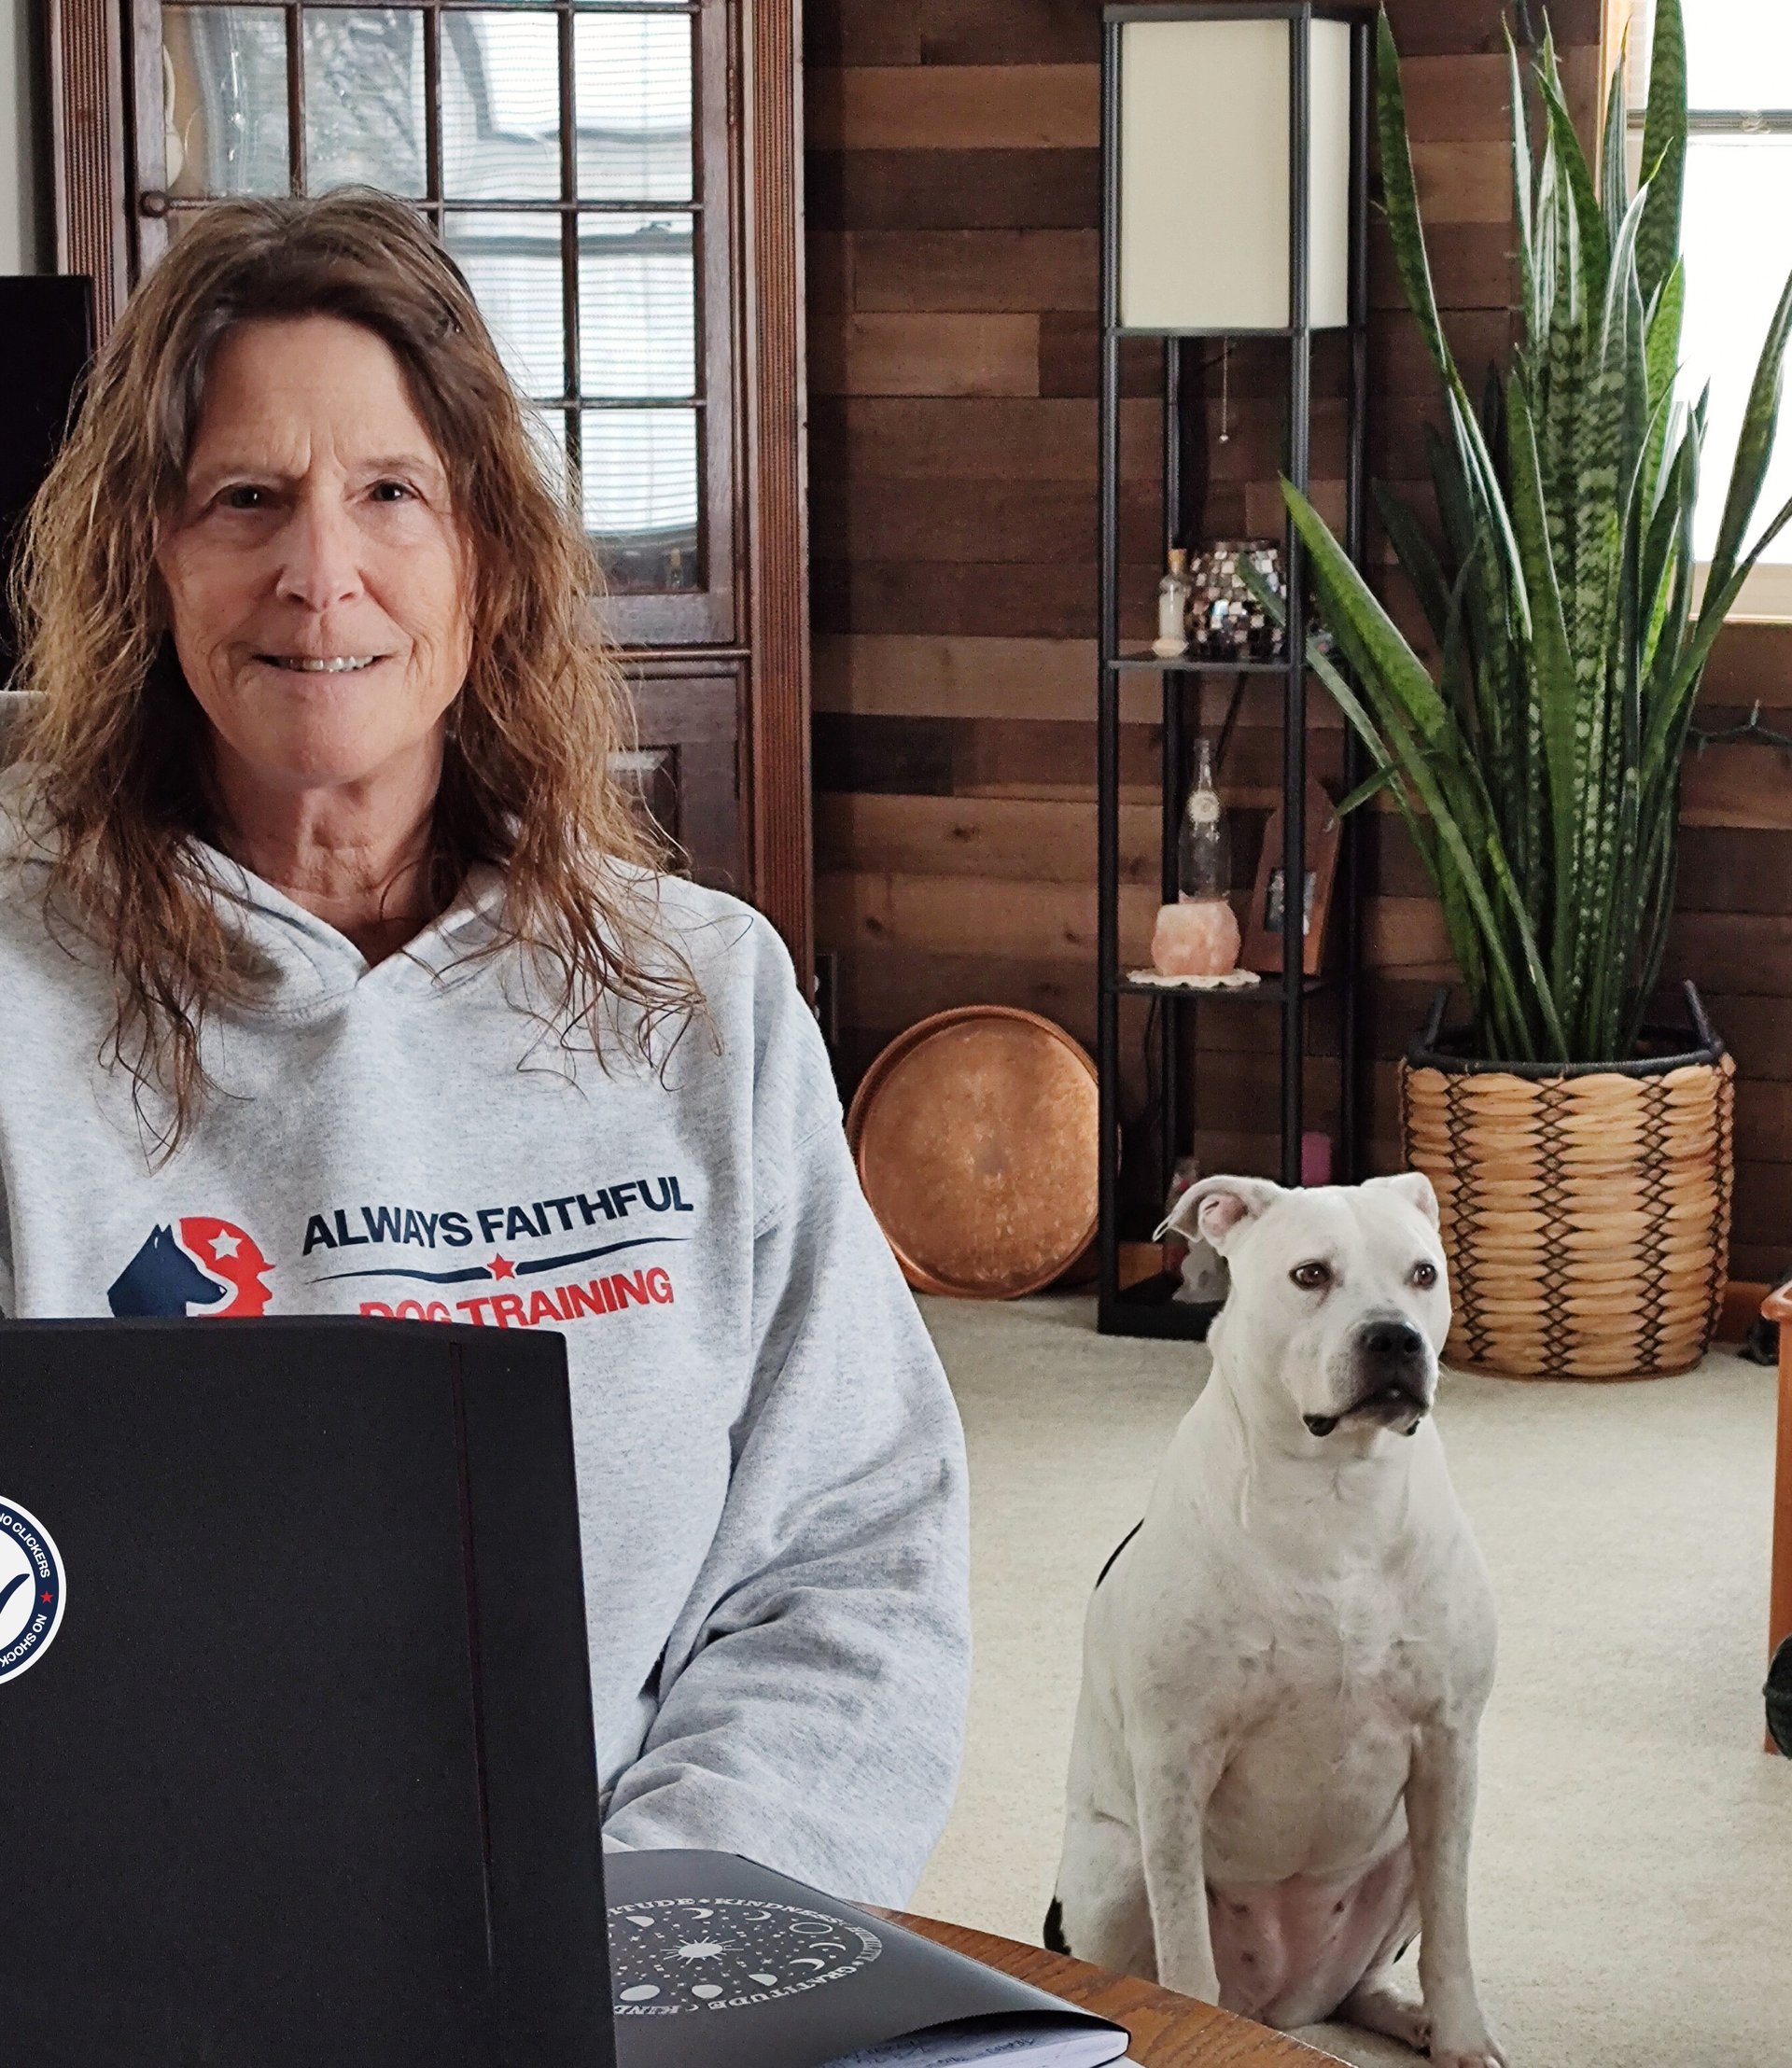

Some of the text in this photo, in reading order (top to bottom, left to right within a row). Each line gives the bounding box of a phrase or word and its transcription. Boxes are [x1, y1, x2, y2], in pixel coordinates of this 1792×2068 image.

[301, 1176, 694, 1257] ALWAYS FAITHFUL
[455, 1266, 675, 1331] TRAINING
[12, 1522, 51, 1579] CLICKERS
[0, 1614, 48, 1668] NO SHOCK
[607, 1897, 696, 1918] ITUDE
[707, 1965, 858, 2010] GRATITUDE
